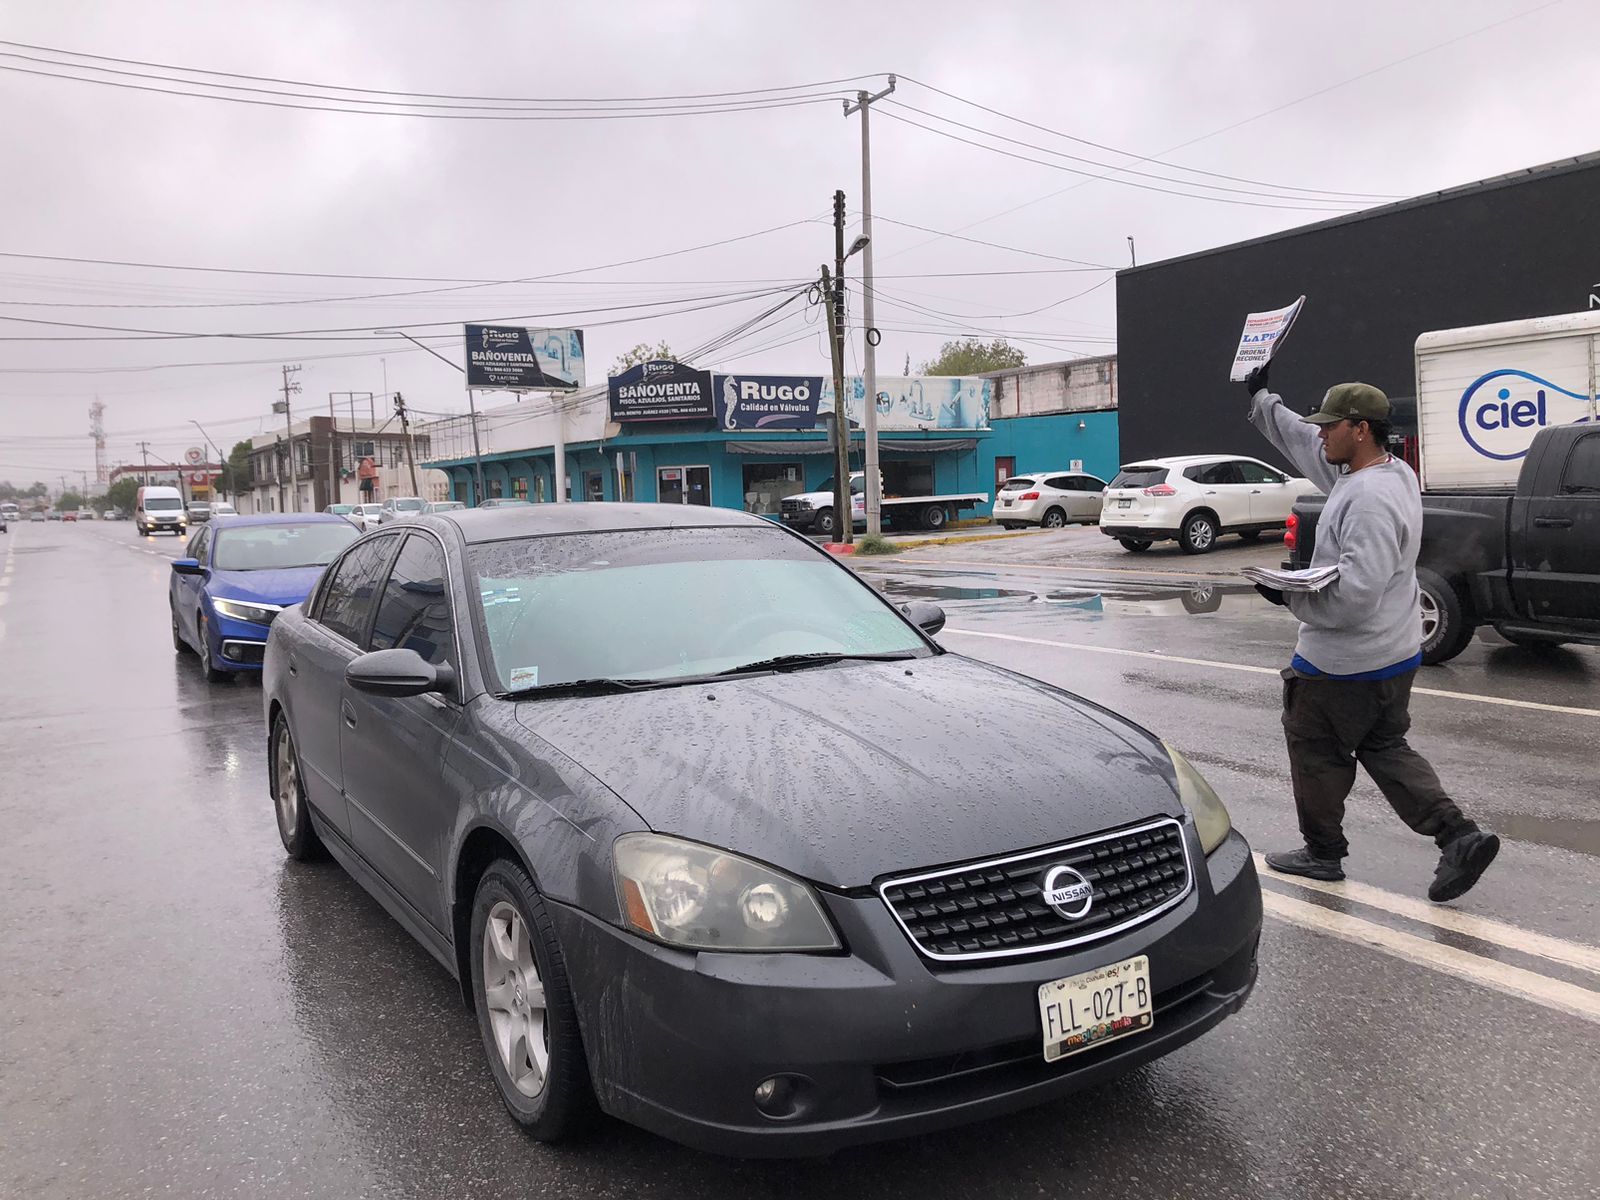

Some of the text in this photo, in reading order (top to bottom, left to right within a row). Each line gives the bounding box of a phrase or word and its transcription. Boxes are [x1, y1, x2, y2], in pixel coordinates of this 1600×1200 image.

[471, 350, 534, 362] BAÑOVENTA
[1239, 348, 1266, 356] ORDENA
[618, 382, 701, 399] BAÑOVENTA
[740, 381, 810, 401] RUGO
[667, 394, 701, 402] SANITARIOS
[740, 402, 810, 412] Calidad en Válvulas
[1475, 388, 1547, 430] ciel
[1051, 885, 1091, 902] NISSAN
